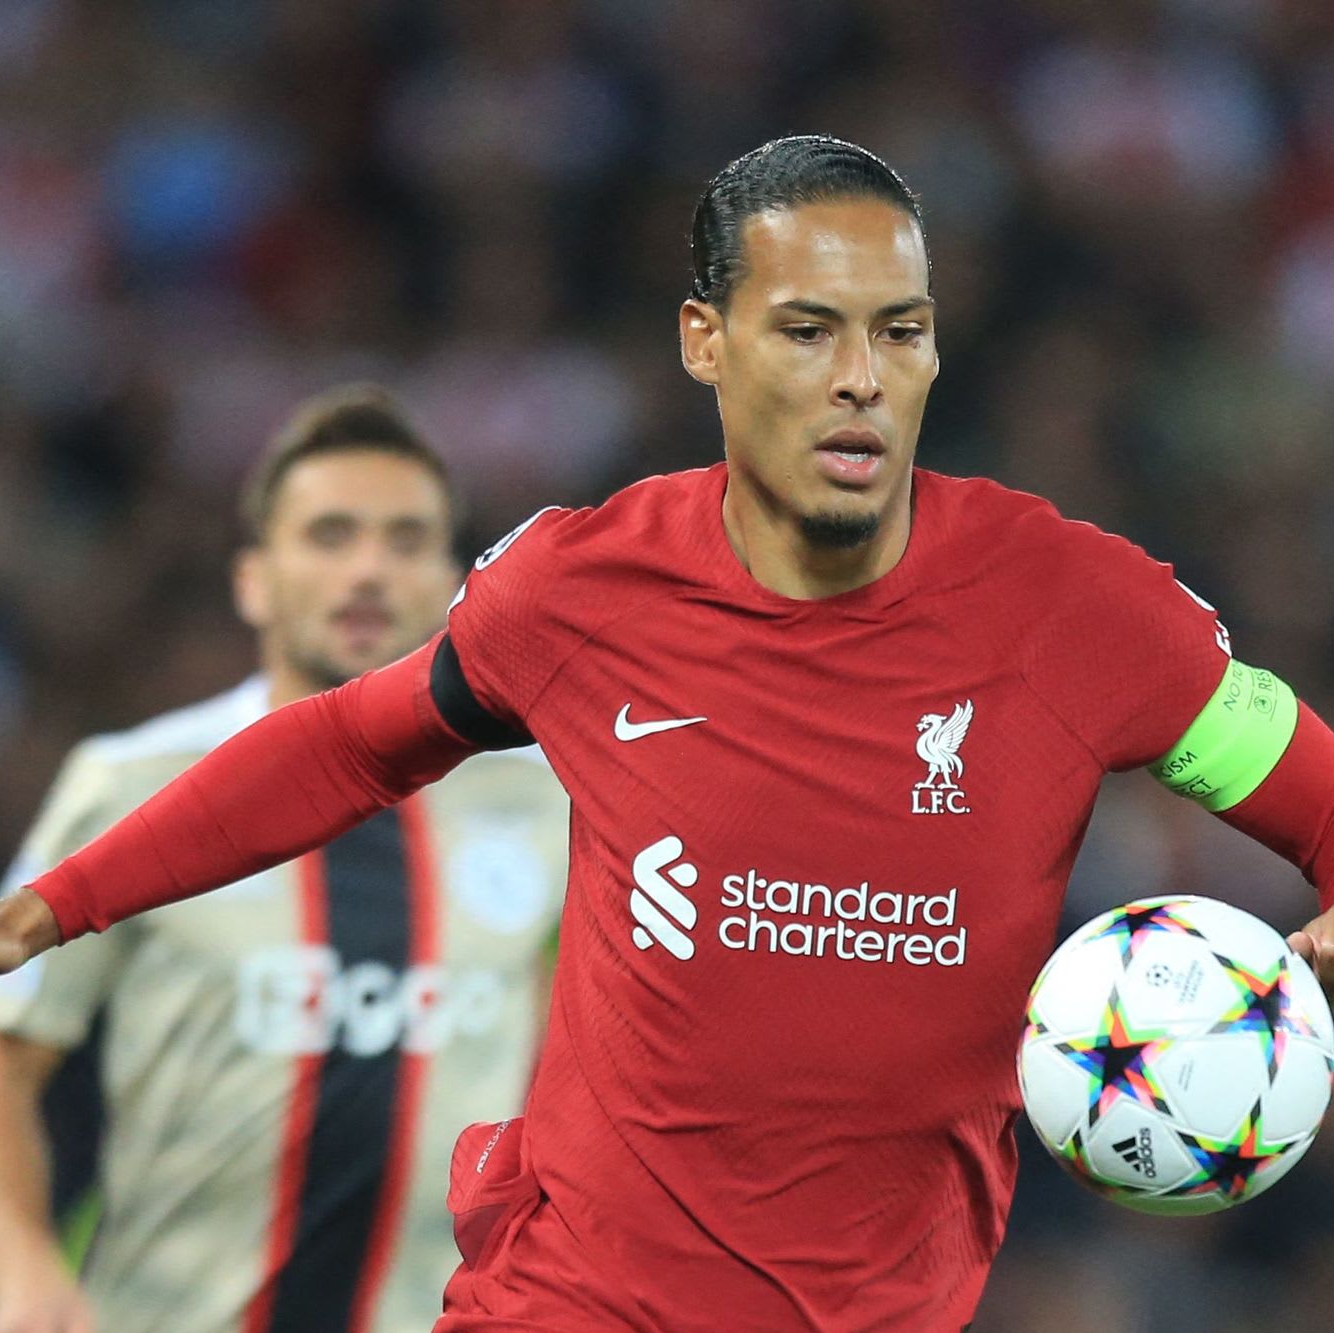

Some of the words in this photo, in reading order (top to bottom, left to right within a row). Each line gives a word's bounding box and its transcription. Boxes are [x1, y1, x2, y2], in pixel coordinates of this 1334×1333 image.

[1223, 682, 1241, 712] NO
[720, 869, 958, 927] standard
[717, 911, 967, 967] chartered
[1138, 1127, 1157, 1178] adidas
